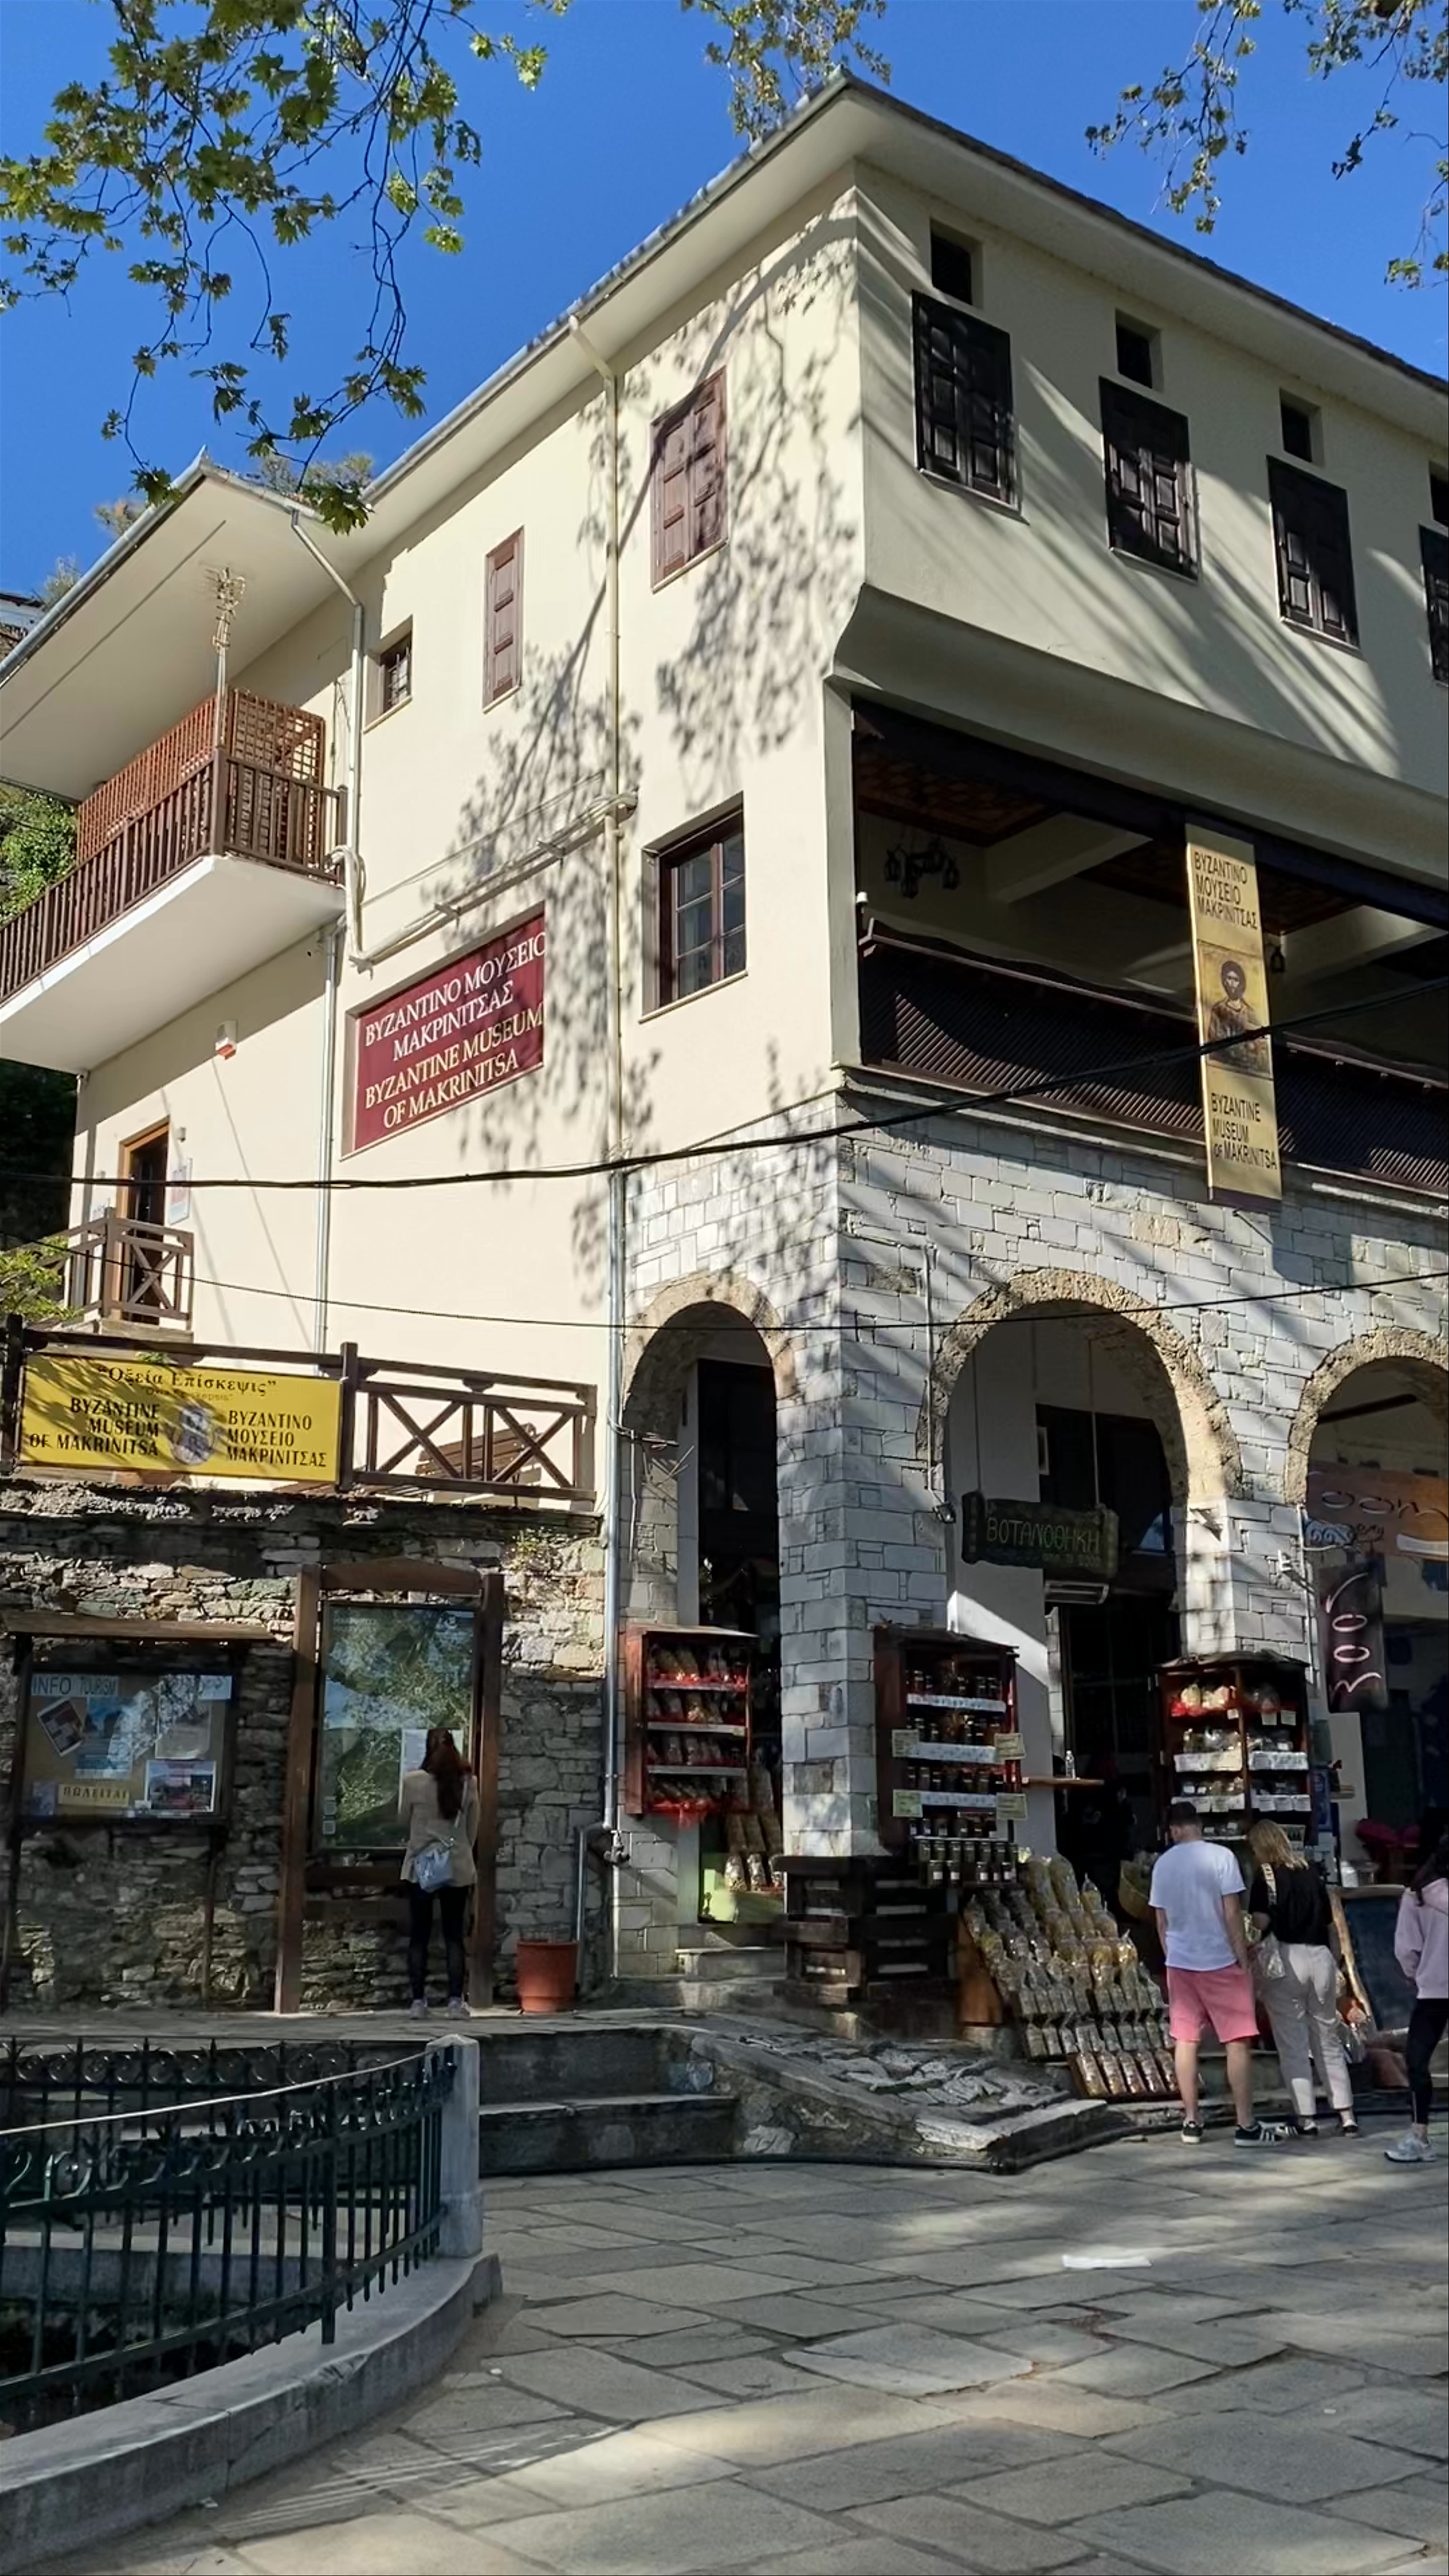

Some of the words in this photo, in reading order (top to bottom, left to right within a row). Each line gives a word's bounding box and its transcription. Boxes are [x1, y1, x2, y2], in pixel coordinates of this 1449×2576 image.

[1195, 851, 1247, 884] ΒΥΖΑΝΤΙΝΟ
[1196, 874, 1241, 905] ΜΟΥΣΕΙΟ
[1198, 896, 1258, 930] ΜΑΚΡΙΝΙΤΣΑΣ
[365, 980, 461, 1046] ΒΥΖΑΝΤΙΝΟ
[464, 932, 545, 994] ΜΟΥΣΕΙΟ
[394, 980, 514, 1061] ΜΑΚΡΙΝΙΤΣΑΣ
[365, 1044, 459, 1109] BYZANTINE
[462, 1003, 544, 1062] MUSEUM
[383, 1101, 406, 1129] OF
[408, 1048, 519, 1118] MAKRINITSA
[1211, 1093, 1261, 1123] BYZANTINE
[1212, 1118, 1249, 1143] MUSEUM
[1224, 1140, 1277, 1170] MAKRINITSA
[71, 1397, 160, 1419] BYZANTINE
[229, 1410, 312, 1430] ΒΥΖΑΝΤΙΝΟ
[89, 1418, 158, 1437] MUSEUM
[228, 1428, 294, 1447] ΜΟΥΣΕΙΟ
[30, 1433, 49, 1448] OF
[58, 1434, 158, 1456] MAKRINITSA
[227, 1446, 327, 1467] ΜΑΚΡΙΝΙΤΣΑΣ
[986, 1516, 1100, 1553] ΒΟΤΑΝΟΘΗΚΗ
[32, 1676, 71, 1695] INFO
